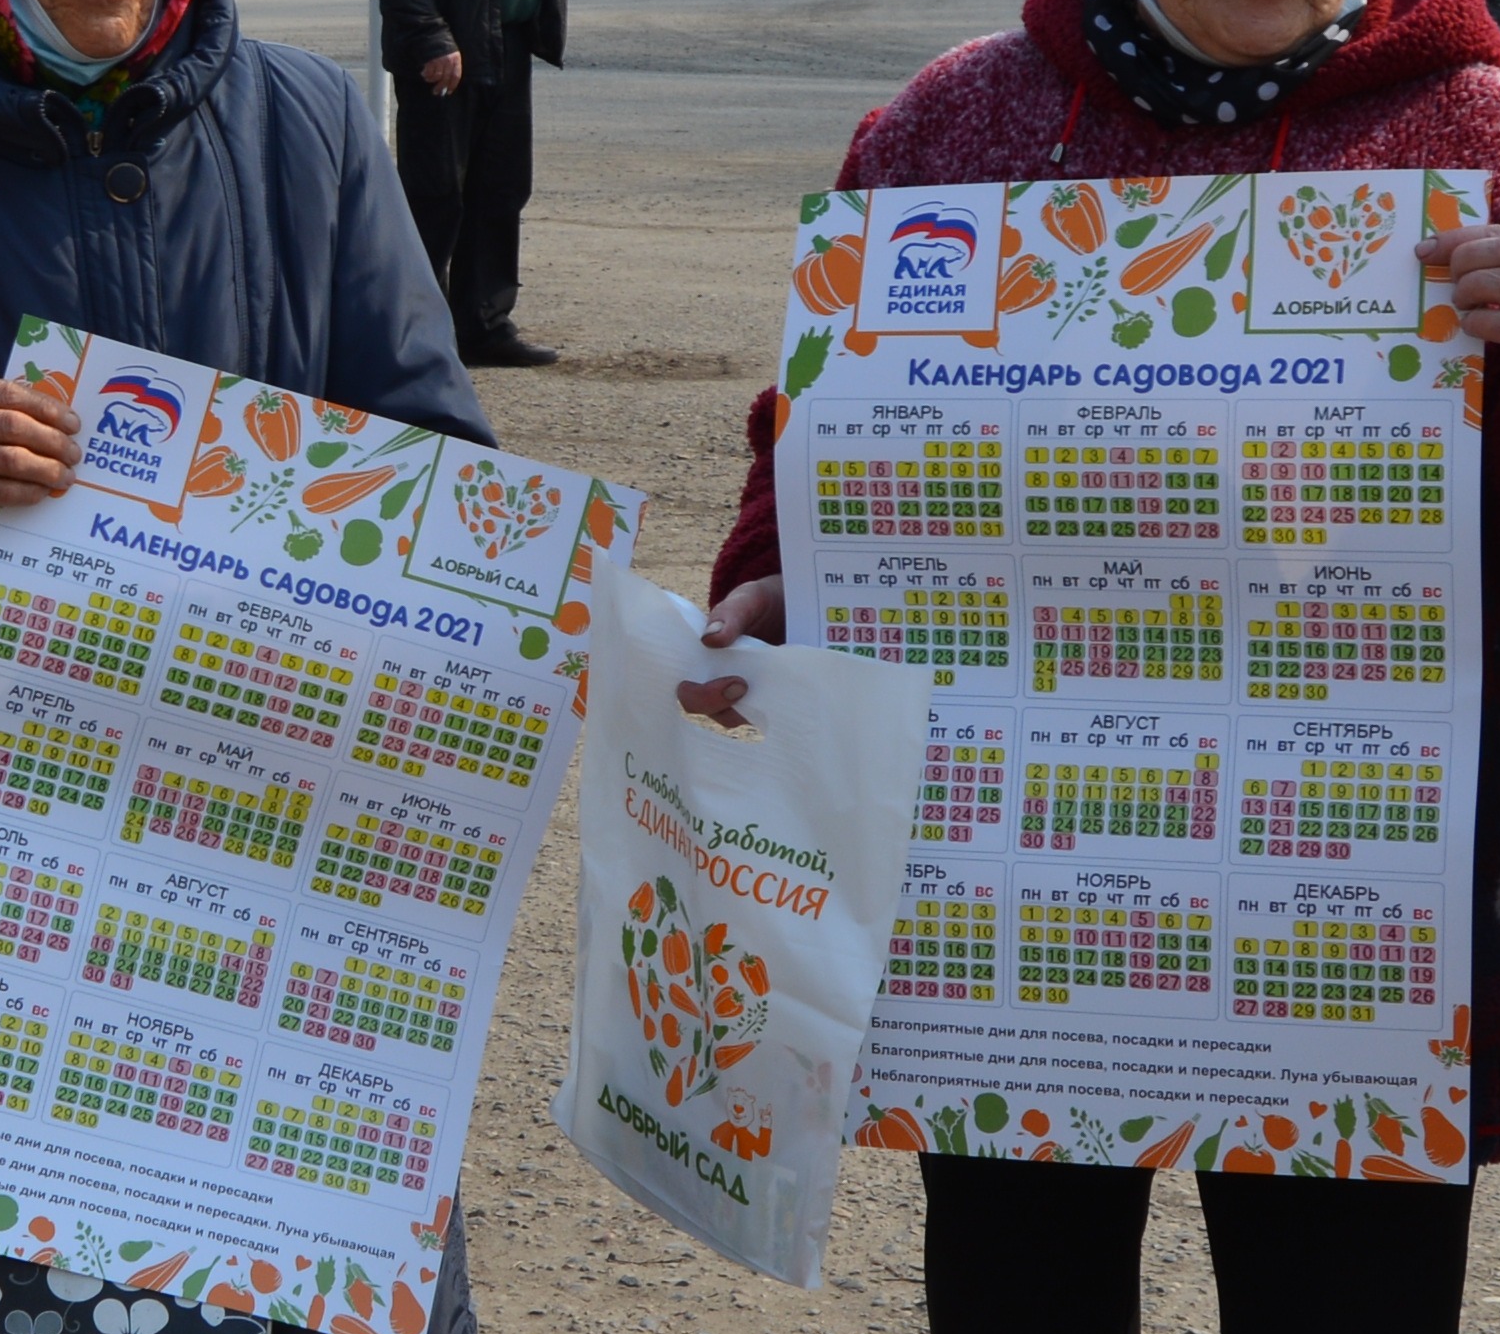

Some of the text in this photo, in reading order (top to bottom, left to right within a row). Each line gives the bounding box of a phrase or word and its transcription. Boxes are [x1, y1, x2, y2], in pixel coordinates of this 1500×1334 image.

[887, 283, 967, 300] ЕДИНАЯ
[886, 299, 965, 315] РОССИЯ
[1271, 299, 1397, 316] ДОБРЫЙ САД
[1268, 357, 1345, 385] 2021
[871, 404, 944, 420] ЯНВАРЬ
[1076, 404, 1162, 421] ФЕВРАЛЬ
[1313, 405, 1367, 421] МАРТ
[86, 436, 162, 468] ЕДИНАЯ
[82, 451, 158, 484] РОССИЯ
[48, 545, 116, 576] ЯНВАРЬ
[876, 556, 948, 572] АПРЕЛЬ
[1102, 560, 1143, 576] МАЙ
[1313, 565, 1372, 581] ИЮНЬ
[429, 555, 539, 598] ДОБРЫЙ САД
[236, 600, 313, 633] ФЕВРАЛЬ
[413, 606, 484, 647] 2021
[444, 659, 493, 684] МАРТ
[7, 684, 76, 713] АПРЕЛЬ
[1089, 713, 1161, 731] АВГУСТ
[1292, 722, 1394, 740] СЕНТЯБРЬ
[215, 740, 254, 762] МАЙ
[400, 792, 452, 817] ИЮНЬ
[625, 751, 637, 780] С
[707, 819, 837, 882] заботой,
[164, 872, 230, 900] АВГУСТ
[694, 844, 831, 922] РОССИЯ
[1075, 871, 1152, 890] НОЯБРЬ
[1292, 883, 1380, 902] ДЕКАБРЬ
[343, 920, 430, 955] СЕНТЯБРЬ
[125, 1011, 194, 1042] НОЯБРЬ
[869, 1015, 1272, 1054] Благоприятные дни для посева, посадки и пересадки
[317, 1062, 394, 1093] ДЕКАБРЬ
[870, 1041, 1418, 1088] Благоприятные дни для посева, посадки и пересадки. Луна убывающая
[870, 1066, 1290, 1107] Неблагоприятные дни для посева, посадки и пересадки
[596, 1082, 751, 1207] ДОБРЫЙ САД
[13, 1135, 42, 1149] дни
[42, 1142, 71, 1157] для
[73, 1149, 125, 1172] посева,
[128, 1163, 186, 1185] посадки
[188, 1177, 198, 1187] и
[200, 1180, 274, 1205] пересадки
[7, 1159, 36, 1174] дни
[37, 1166, 66, 1181] для
[67, 1173, 120, 1196] посева,
[123, 1186, 181, 1208] посадки
[183, 1200, 194, 1210] и
[195, 1203, 271, 1230] пересадки.
[274, 1220, 310, 1239] Луна
[311, 1231, 396, 1261] убывающая
[18, 1186, 47, 1200] дни
[47, 1193, 76, 1207] для
[78, 1200, 131, 1222] посева,
[134, 1213, 192, 1234] посадки
[194, 1226, 204, 1237] и
[206, 1230, 280, 1255] пересадки
